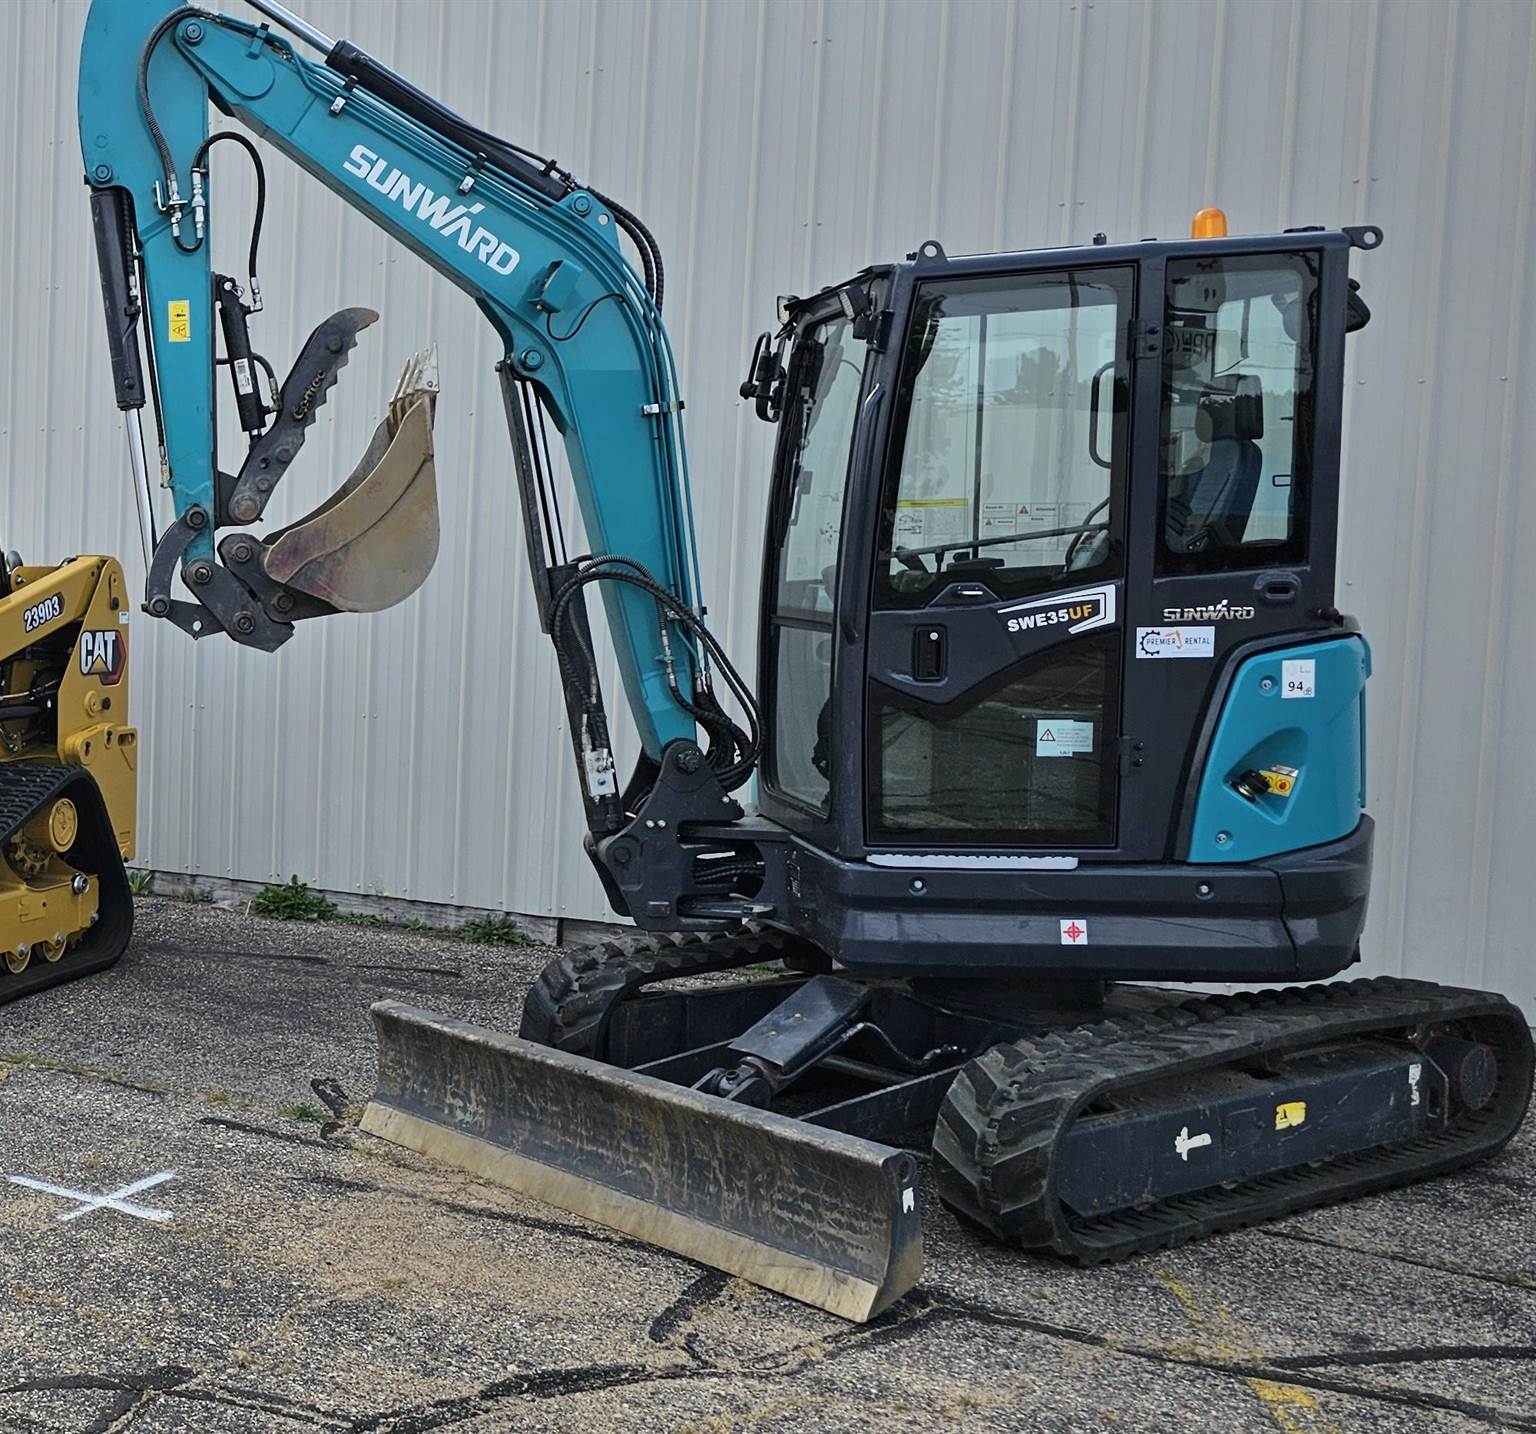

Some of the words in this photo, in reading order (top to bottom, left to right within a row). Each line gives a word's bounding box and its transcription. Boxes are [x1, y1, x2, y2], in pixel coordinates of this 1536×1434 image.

[342, 144, 521, 276] SUNWARD
[24, 595, 61, 633] 239D3
[1007, 603, 1093, 632] SWE35UF
[1162, 599, 1255, 622] SUNWARD
[80, 630, 116, 675] CAT
[1146, 637, 1176, 646] PREMIER
[1184, 637, 1211, 645] RENTAL
[1288, 681, 1304, 692] 94
